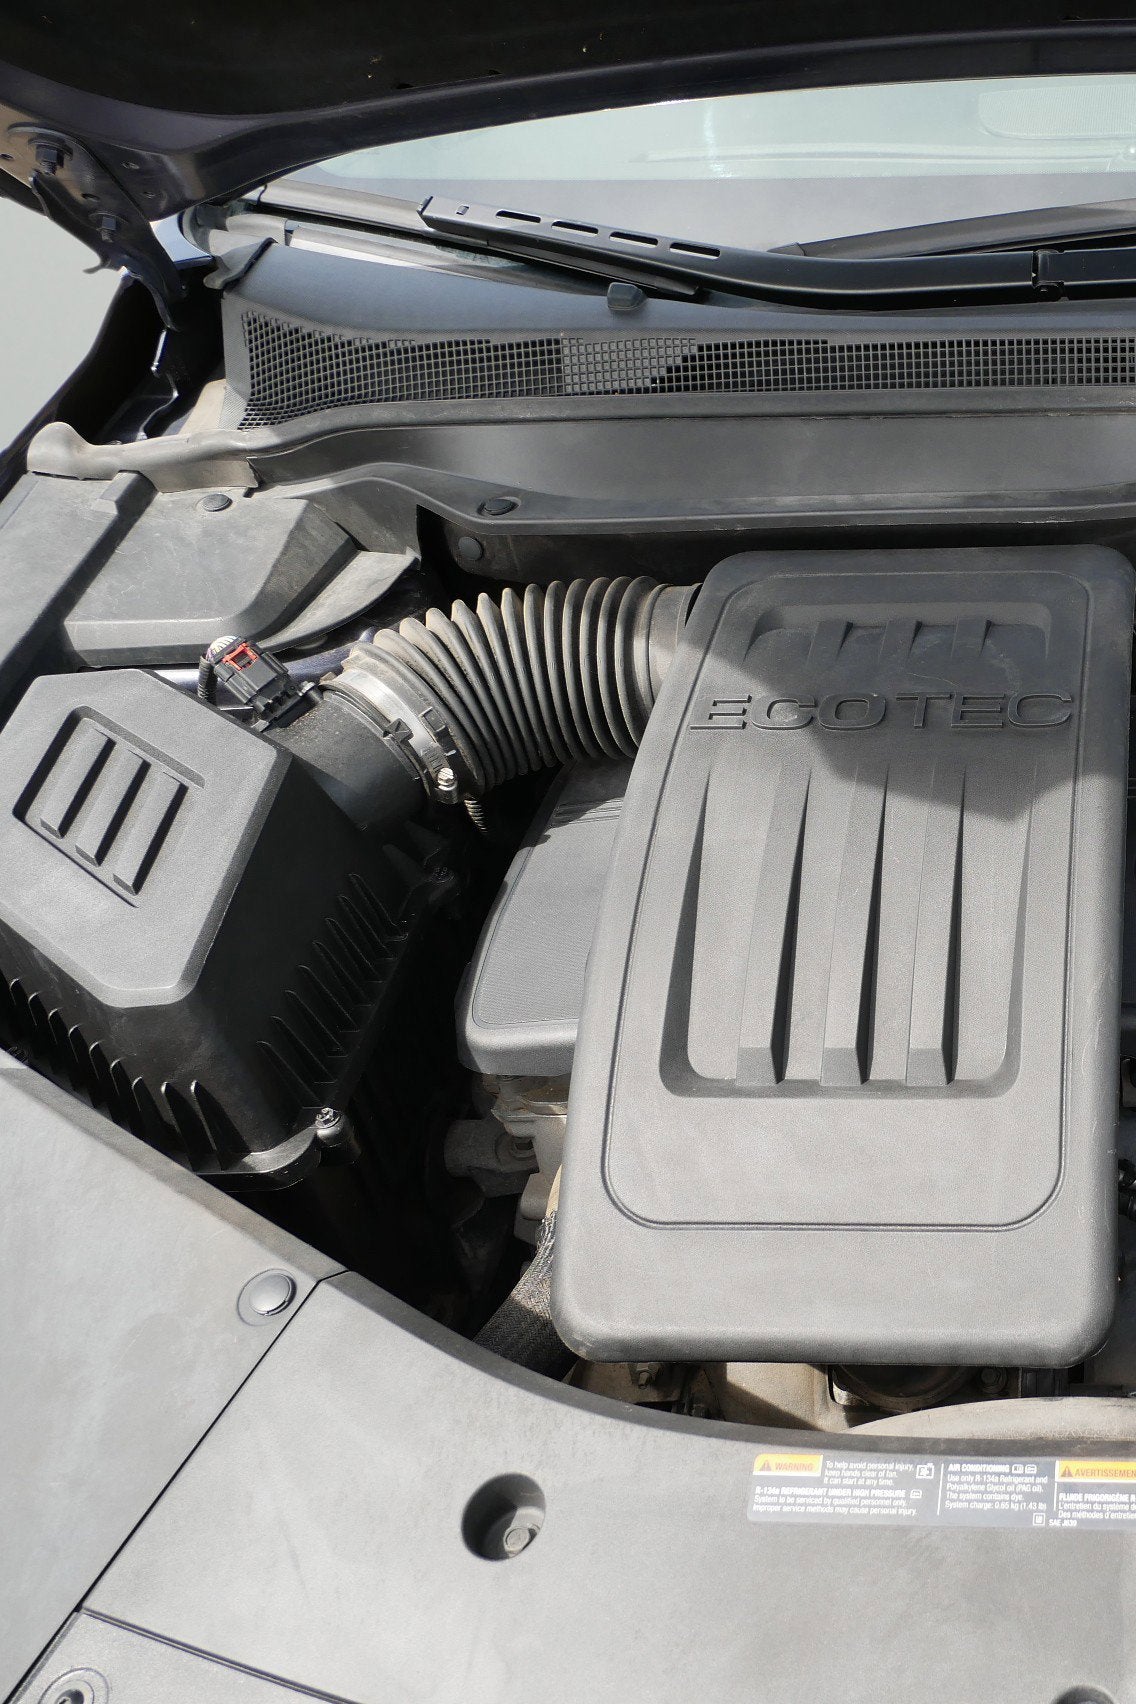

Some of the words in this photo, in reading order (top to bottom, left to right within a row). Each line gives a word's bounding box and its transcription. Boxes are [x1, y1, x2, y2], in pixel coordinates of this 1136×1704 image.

[688, 692, 1073, 731] ECOTEC
[775, 1462, 814, 1472] WARNING
[948, 1463, 960, 1471] AIR
[961, 1464, 1010, 1472] CONDITIONING
[961, 1474, 974, 1483] only
[1000, 1475, 1034, 1484] Refrigerant
[1035, 1475, 1048, 1484] and
[947, 1483, 985, 1492] Polyalkylene
[986, 1484, 1005, 1492] Glycol
[1016, 1484, 1031, 1492] (PAG
[959, 1492, 982, 1500] system
[1059, 1492, 1083, 1501] FLUIDE
[945, 1501, 968, 1509] System
[970, 1501, 993, 1510] charge:
[1011, 1502, 1019, 1511] kg
[1020, 1502, 1037, 1511] (1.43
